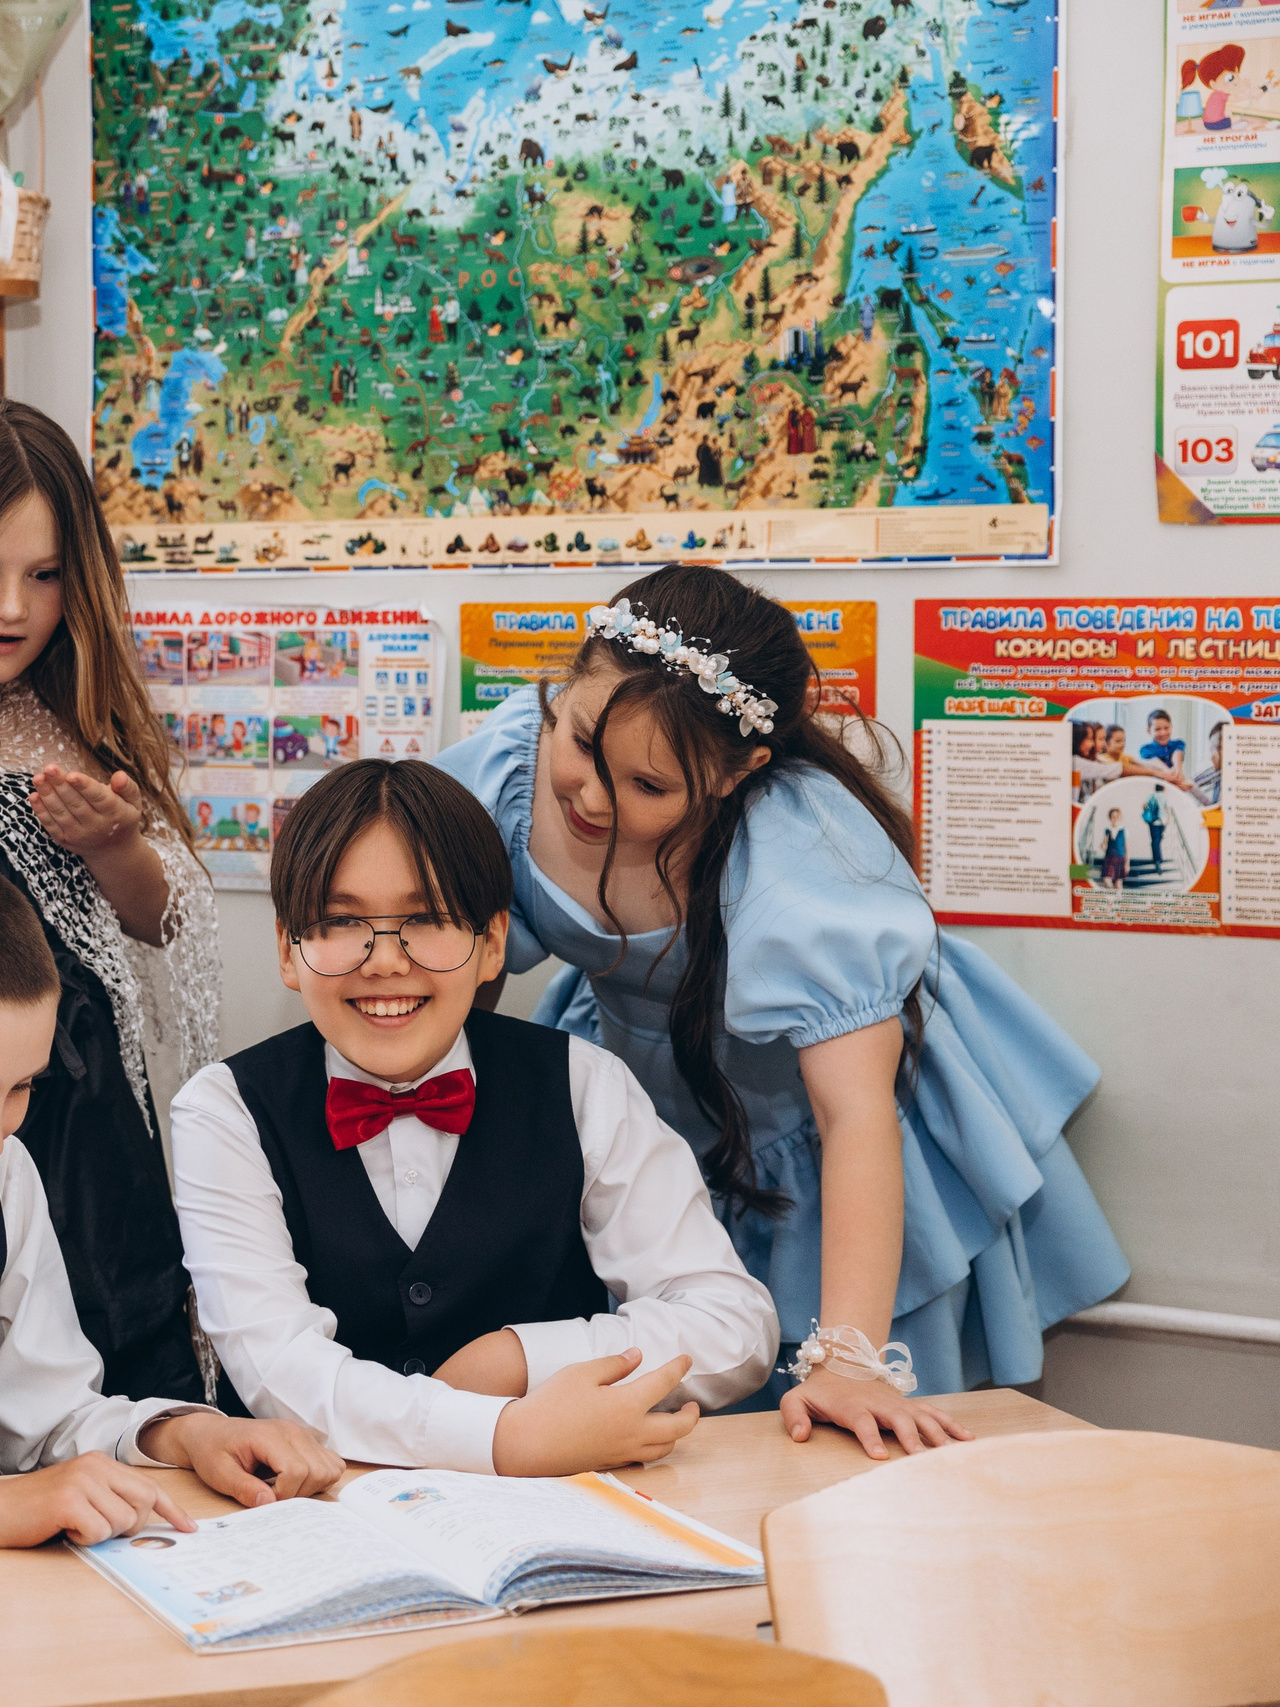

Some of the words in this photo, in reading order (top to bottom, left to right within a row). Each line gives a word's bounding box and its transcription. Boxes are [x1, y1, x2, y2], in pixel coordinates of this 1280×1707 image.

[1180, 330, 1235, 359] 101
[1178, 437, 1234, 463] 103
[124, 611, 193, 625] АВИЛА
[200, 611, 317, 625] ДОРОЖНОГО
[494, 613, 576, 631] ПРАВИЛА
[941, 609, 1044, 630] ПРАВИЛА
[1056, 608, 1194, 631] ПОВЕДЕНИЯ
[1206, 609, 1240, 629] НА
[995, 638, 1118, 661] КОРИДОРЫ
[1136, 638, 1155, 659] И
[947, 699, 1045, 714] РАЗРЕШАЕТСЯ
